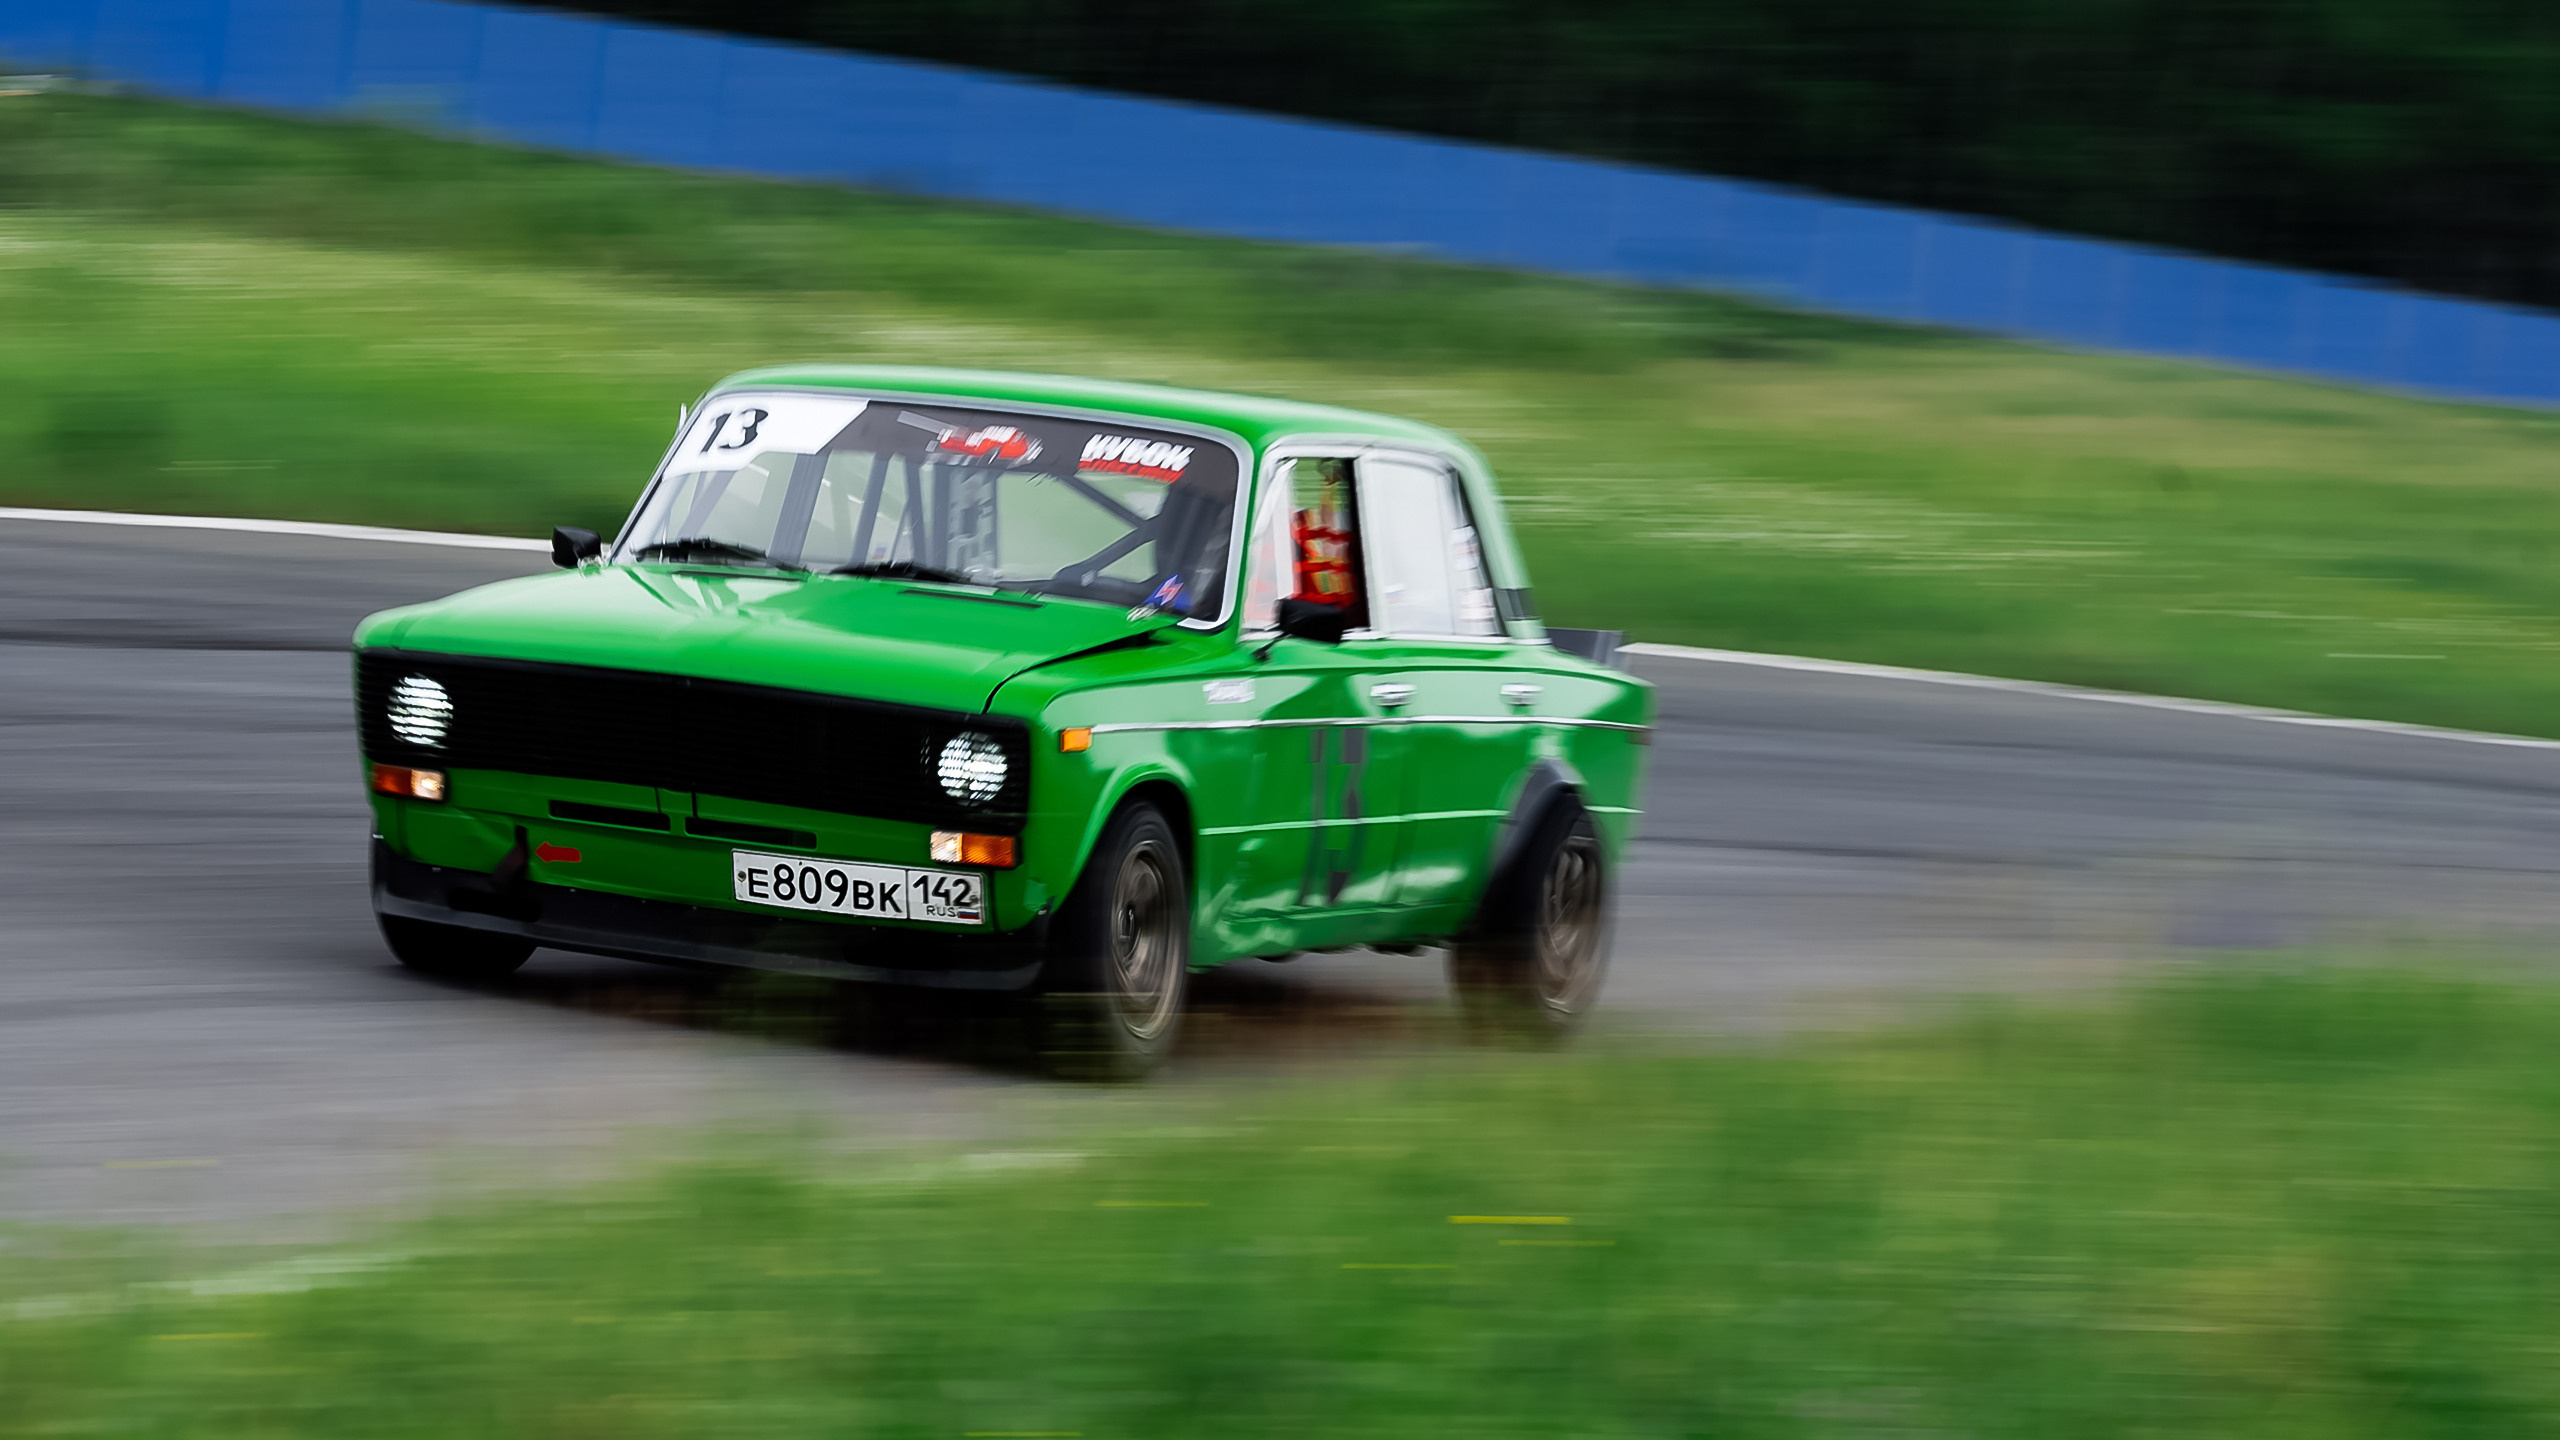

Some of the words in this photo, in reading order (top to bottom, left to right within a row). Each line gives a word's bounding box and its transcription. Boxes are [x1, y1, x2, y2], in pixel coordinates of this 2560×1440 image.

[699, 408, 769, 453] 13
[747, 863, 902, 914] Е809ВК
[912, 875, 972, 907] 142
[926, 904, 957, 918] RUS
